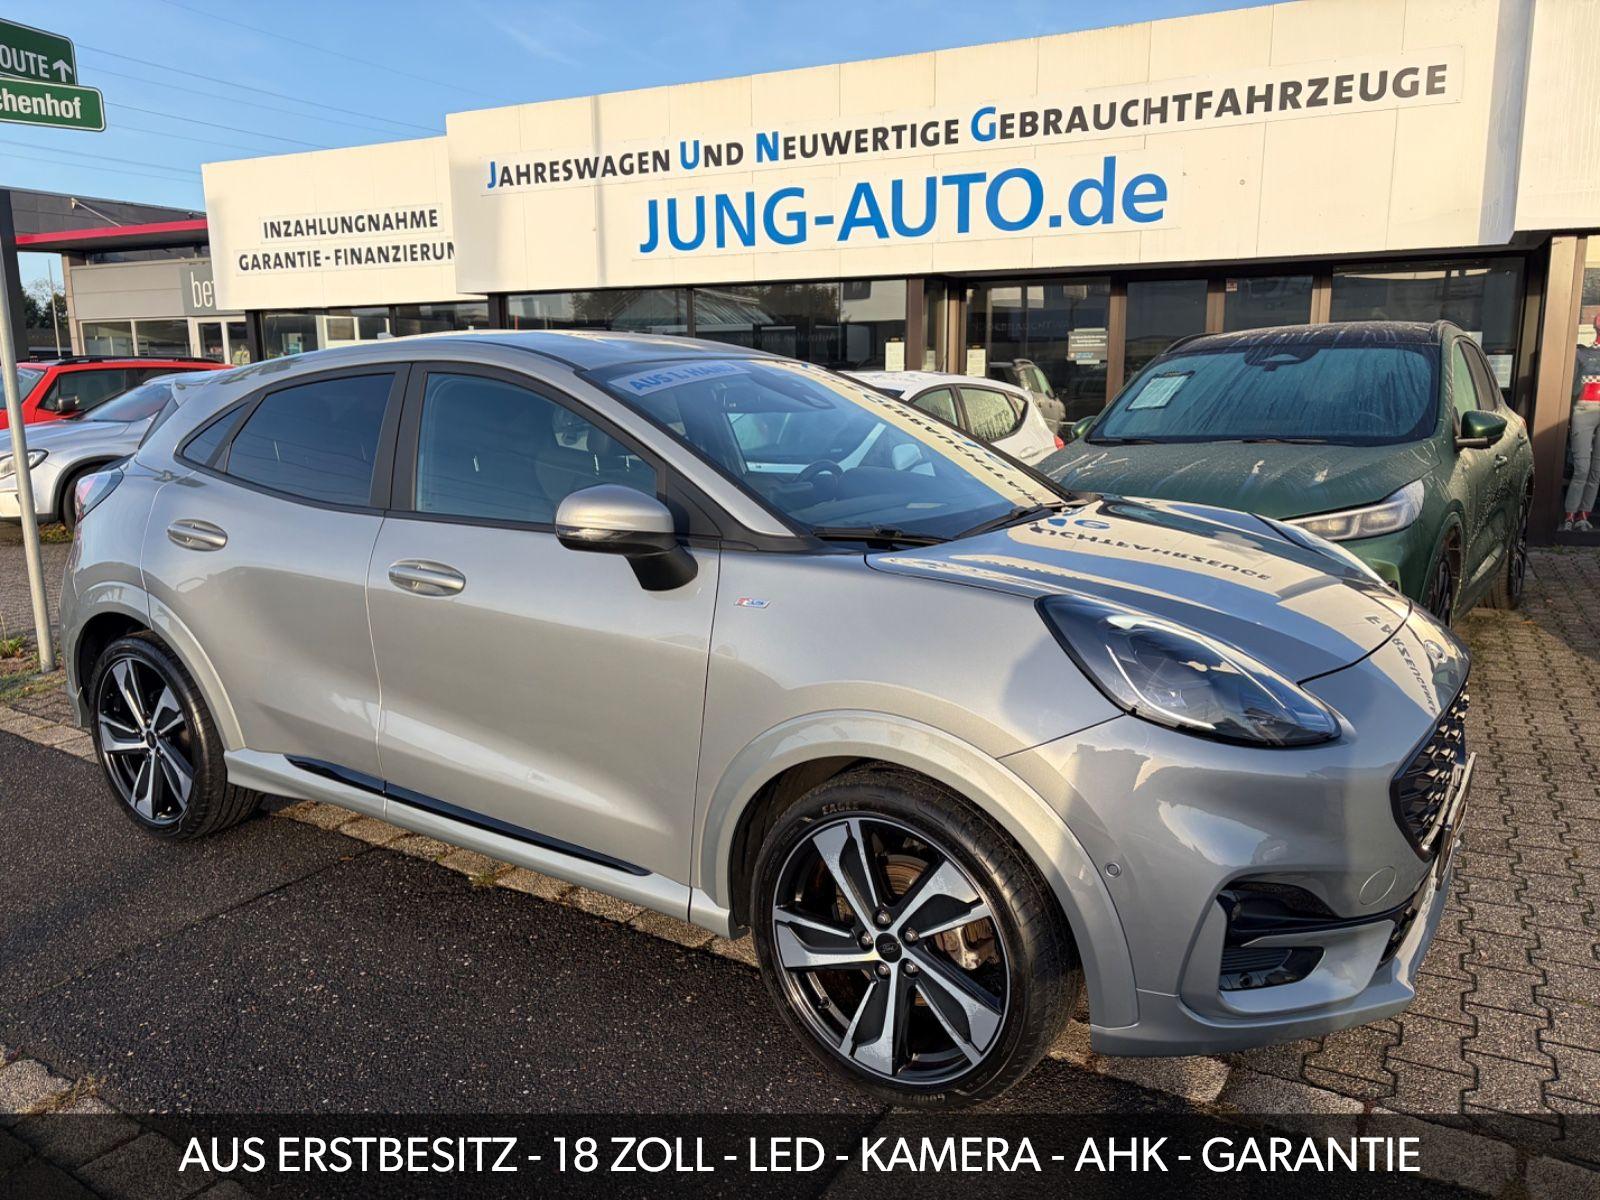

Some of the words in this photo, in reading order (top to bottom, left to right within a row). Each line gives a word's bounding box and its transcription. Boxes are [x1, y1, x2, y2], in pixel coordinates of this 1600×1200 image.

[487, 149, 670, 189] JAHRESWAGEN
[680, 139, 744, 170] UND
[756, 118, 959, 163] NEUWERTIGE
[971, 64, 1448, 142] GEBRAUCHTFAHRZEUGE
[263, 208, 439, 239] INZAHLUNGNAHME
[639, 155, 1168, 253] JUNG-AUTO.de
[190, 271, 214, 309] be
